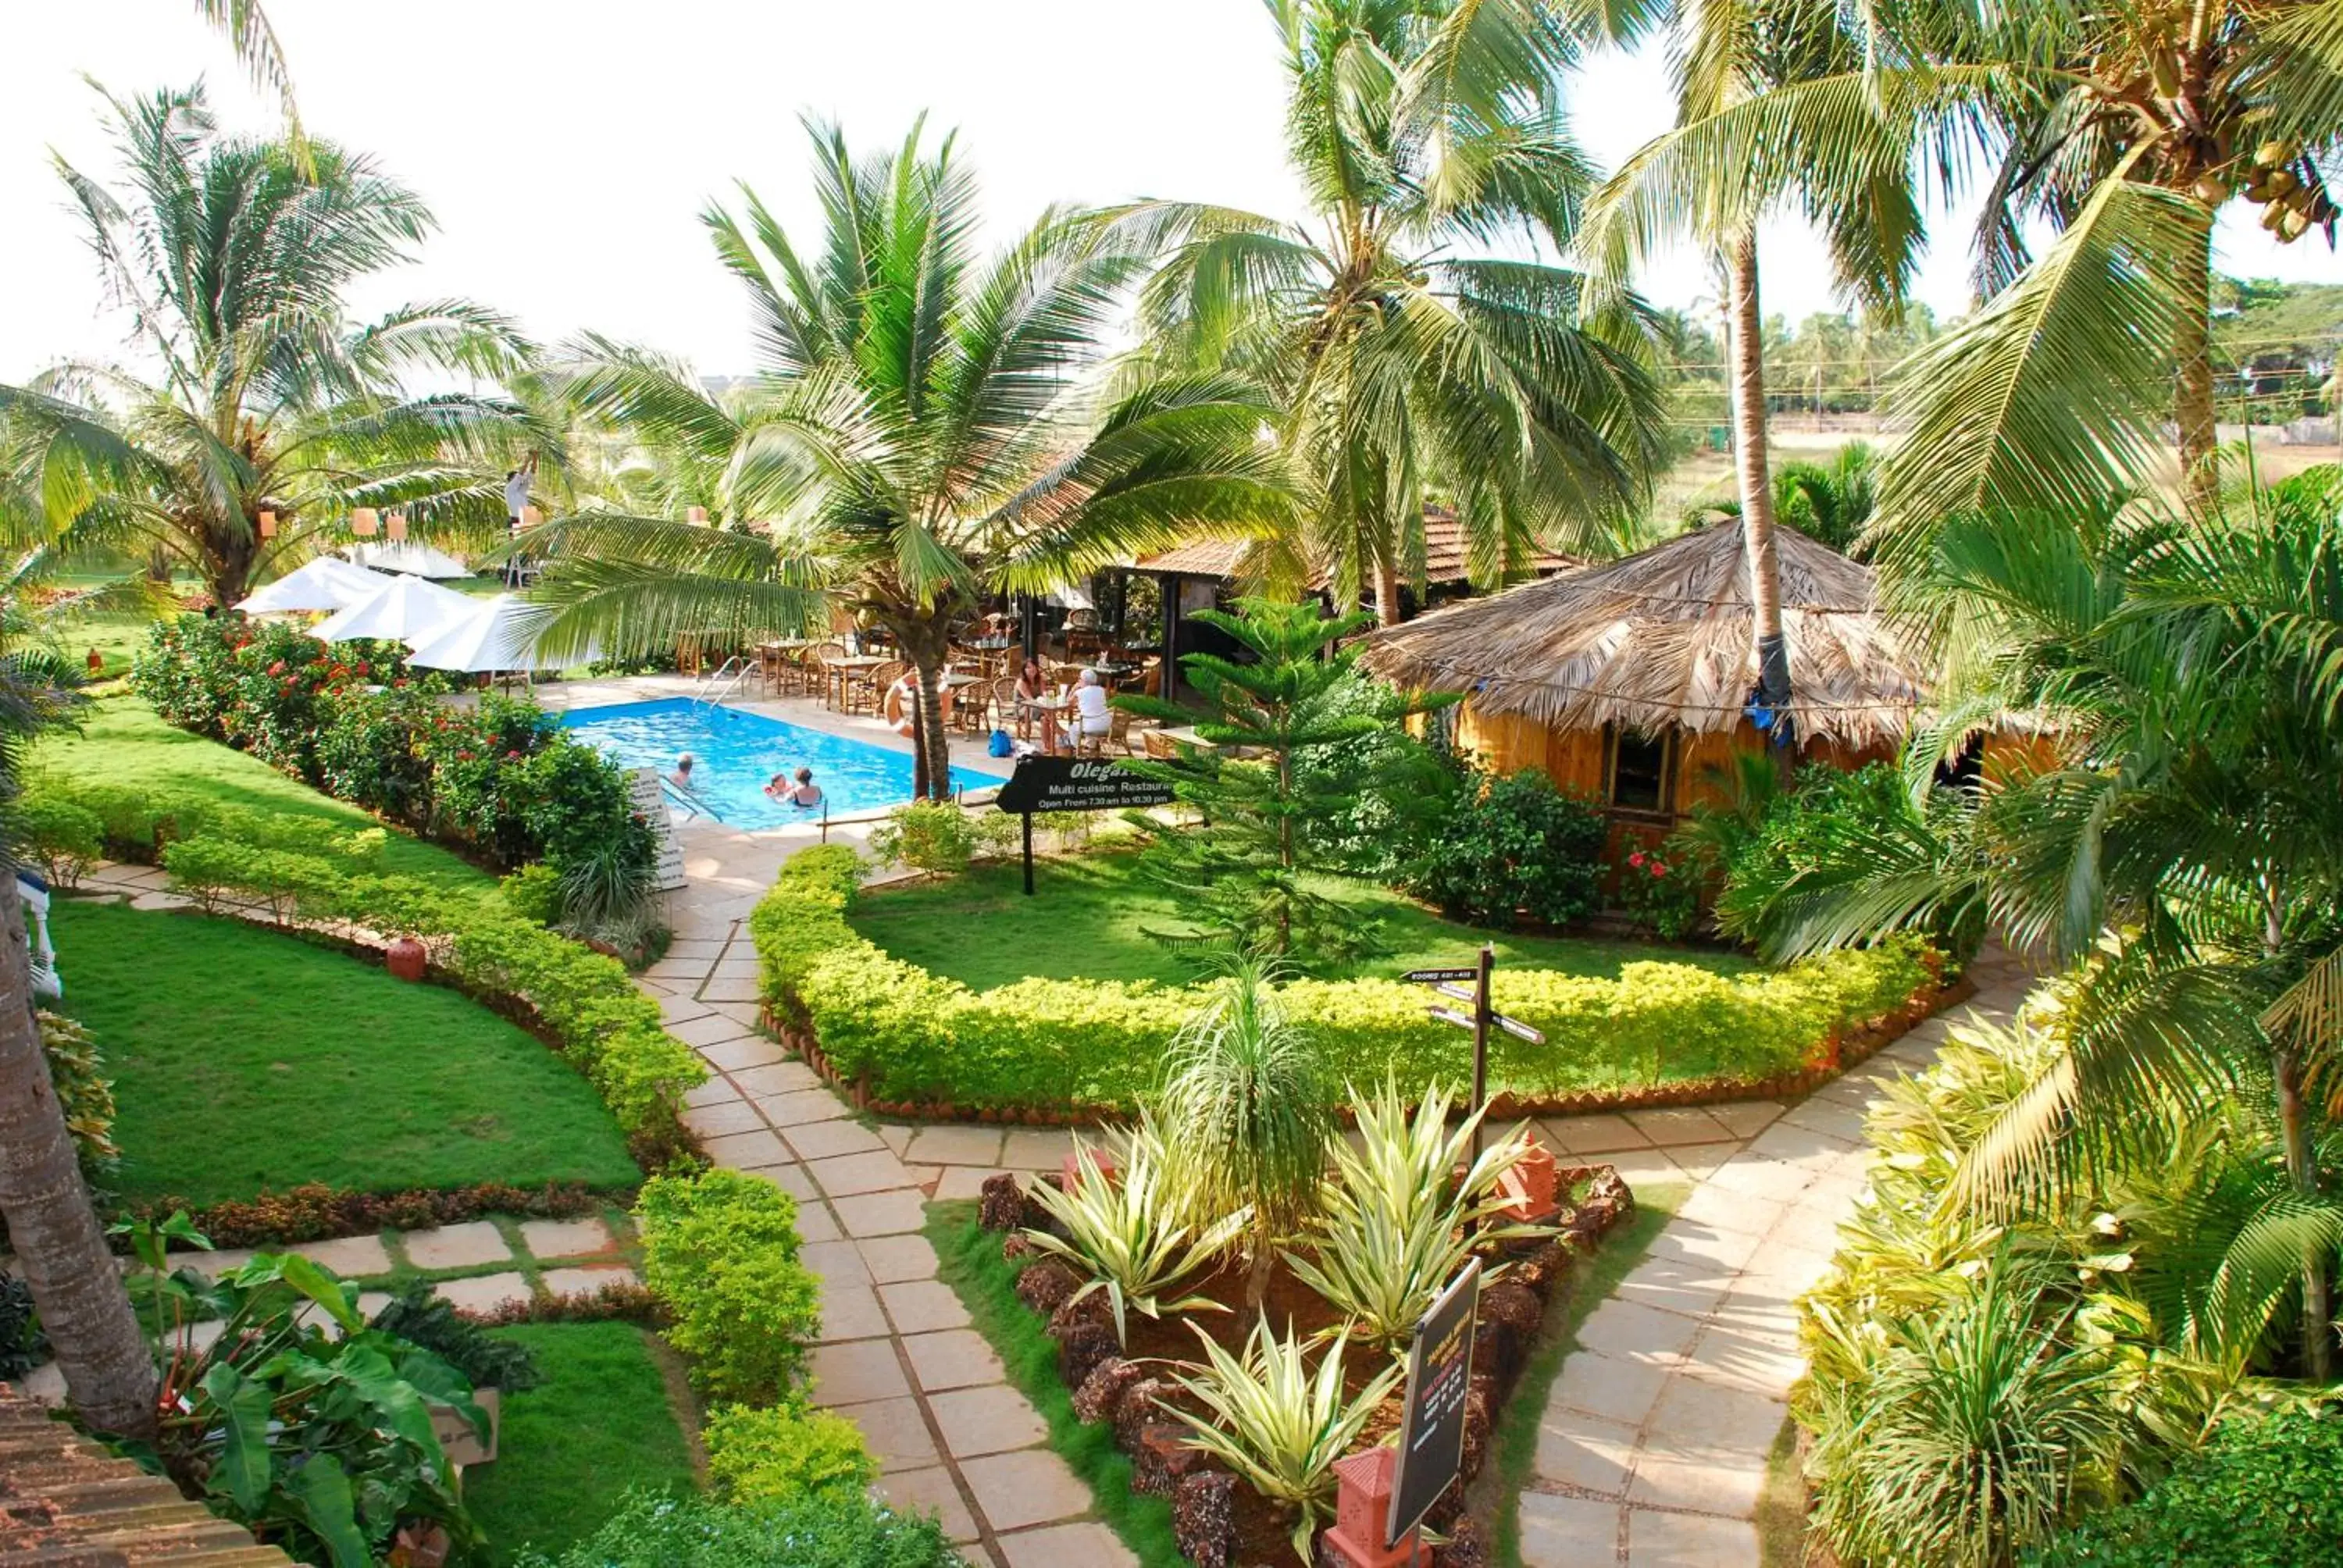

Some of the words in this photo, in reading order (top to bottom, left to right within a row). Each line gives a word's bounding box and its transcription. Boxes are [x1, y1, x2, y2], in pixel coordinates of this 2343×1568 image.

[1049, 784, 1075, 795] Multi
[1077, 782, 1116, 794] cuisine
[1038, 800, 1062, 809] Open
[1064, 798, 1088, 807] From
[1154, 795, 1168, 804] pm
